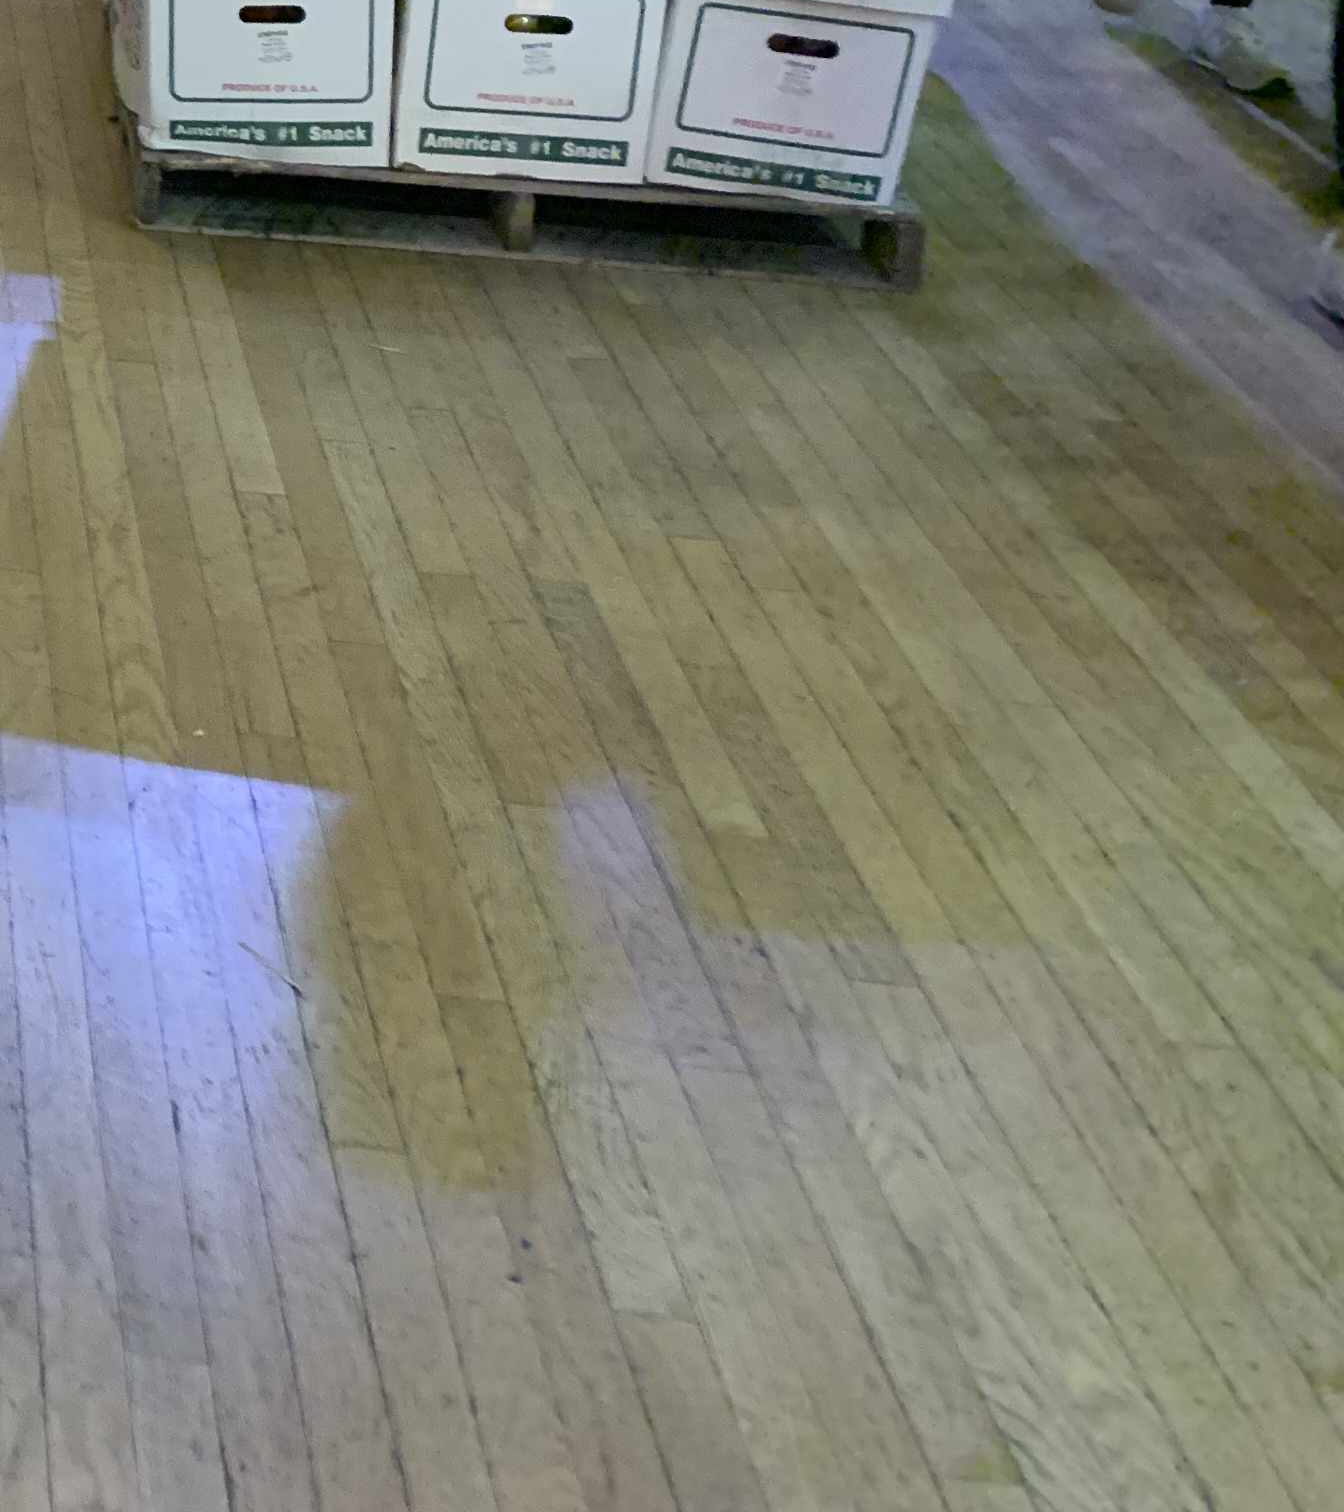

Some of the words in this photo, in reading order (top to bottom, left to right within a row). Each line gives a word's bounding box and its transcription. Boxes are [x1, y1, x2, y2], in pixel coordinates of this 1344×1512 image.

[175, 124, 266, 141] America's
[278, 126, 298, 141] #1
[309, 125, 368, 144] Snack
[425, 134, 517, 153] America's
[529, 140, 551, 157] #1
[562, 141, 622, 161] Snack
[672, 153, 772, 179] America's
[816, 173, 874, 194] Snack
